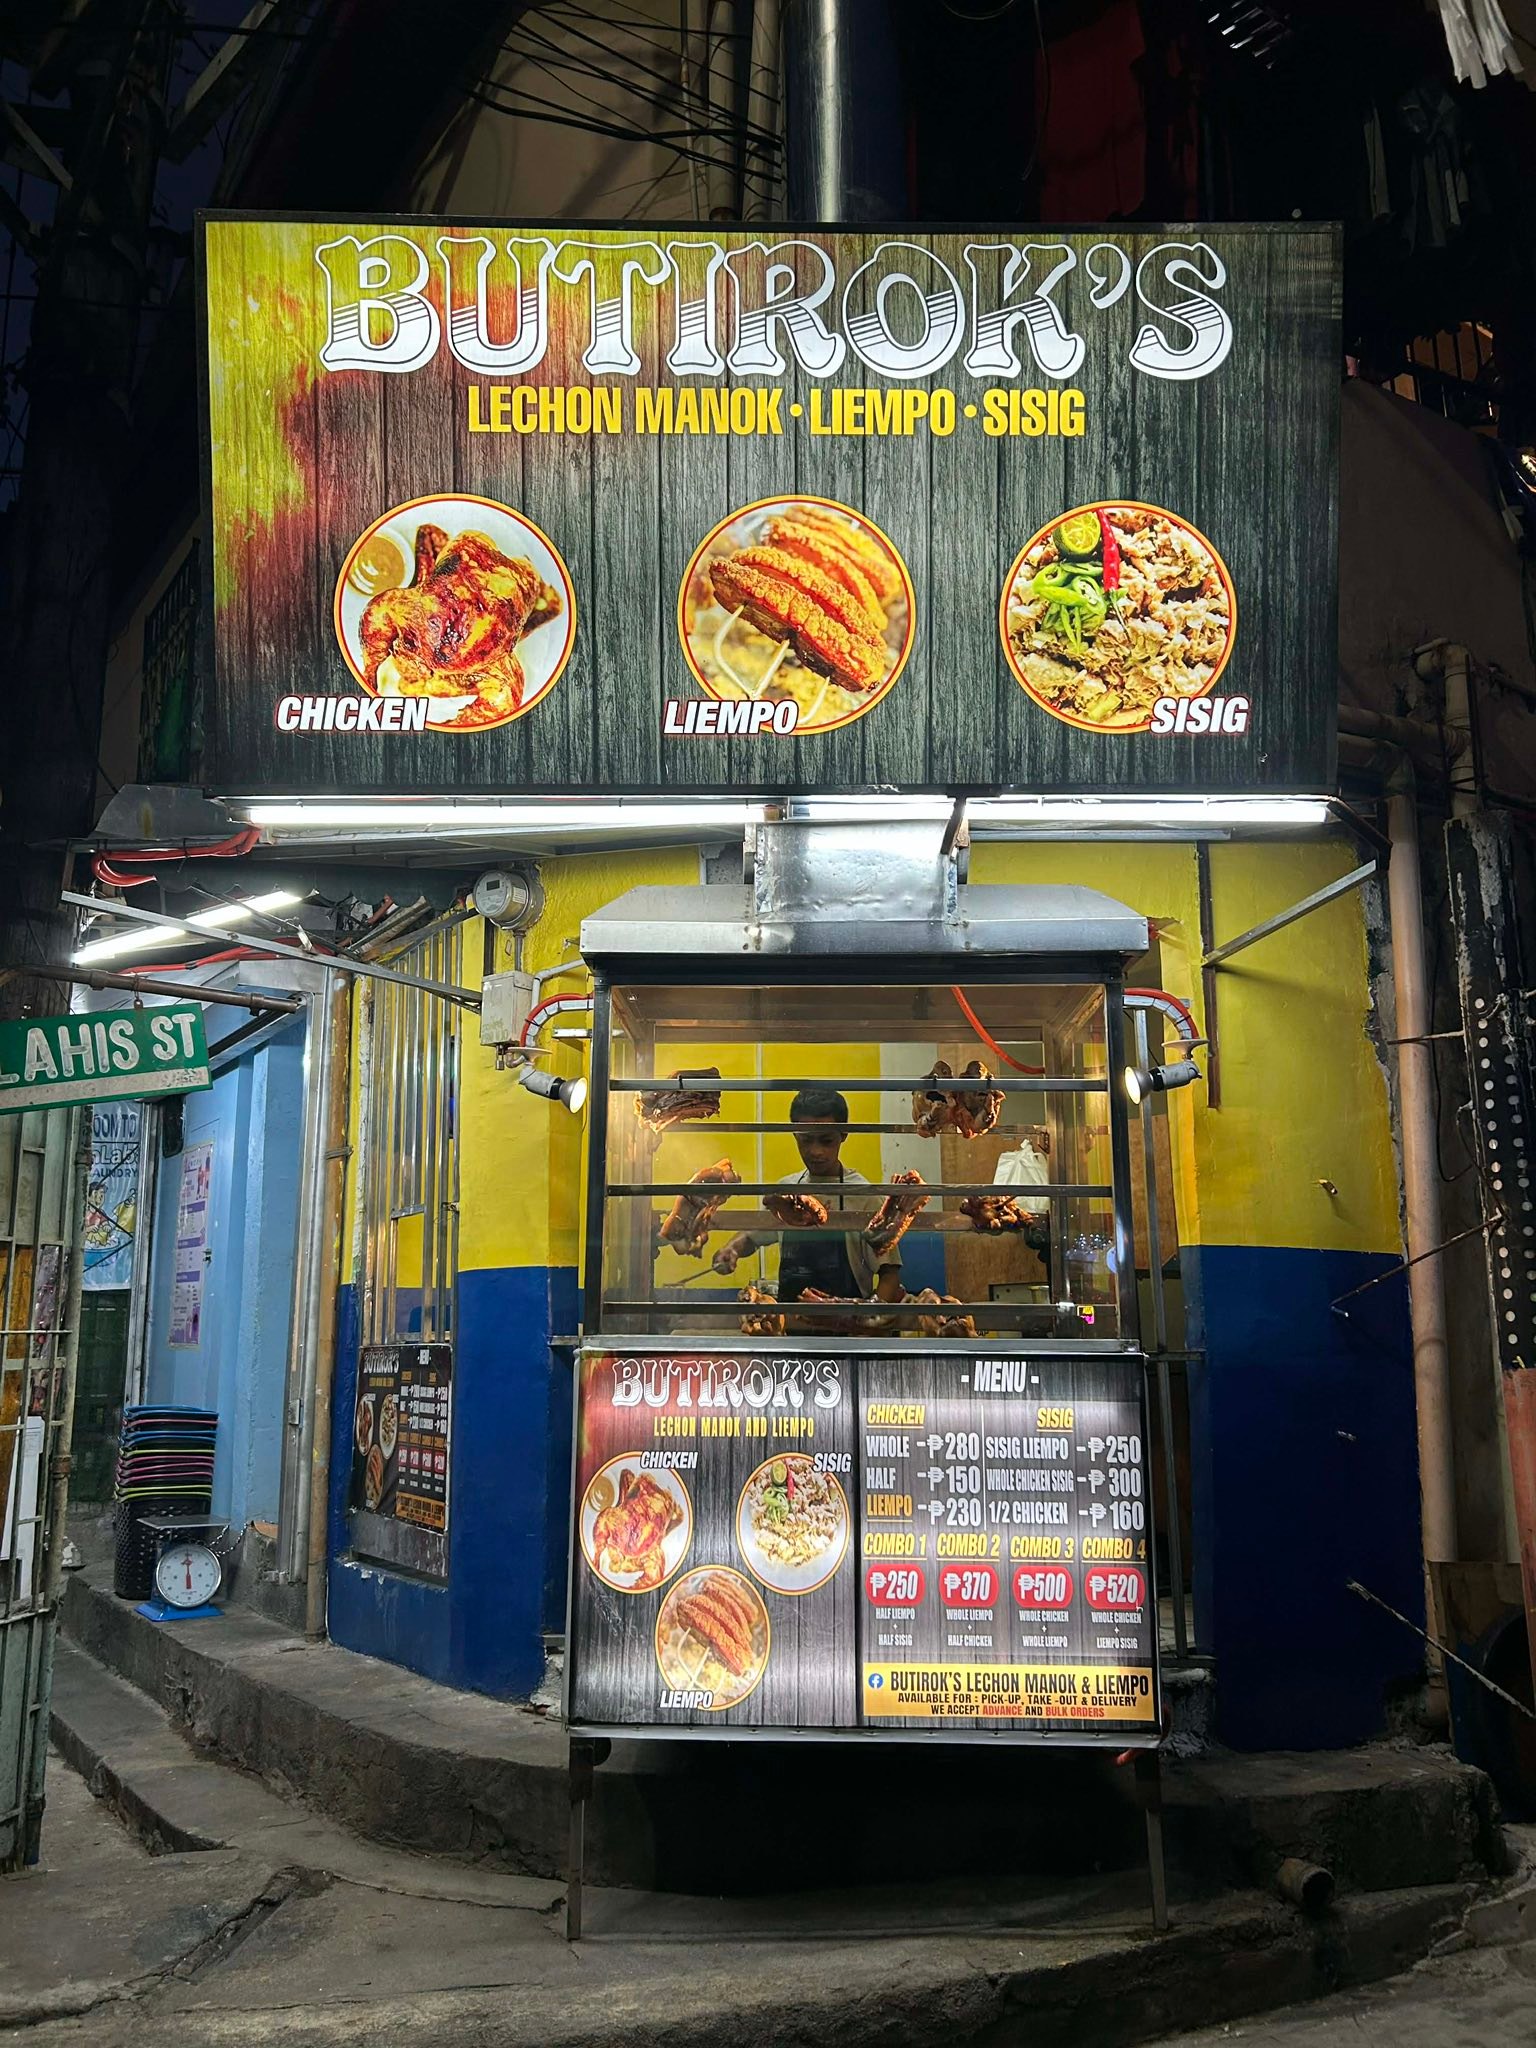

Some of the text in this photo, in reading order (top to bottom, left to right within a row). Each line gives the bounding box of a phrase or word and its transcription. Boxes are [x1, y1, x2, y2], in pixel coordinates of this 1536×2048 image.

[314, 235, 1233, 380] BUTIROK'S
[468, 385, 1085, 437] LECHON MANOK LIEMPO SISIG
[276, 695, 429, 734] CHICKEN
[663, 699, 800, 736] LIEMPO
[1149, 695, 1250, 735] SISIG
[151, 1013, 196, 1061] ST
[611, 1359, 842, 1408] BUTIROK'S
[867, 1404, 925, 1425] CHICKEN
[1037, 1407, 1074, 1429] SISIG
[654, 1416, 814, 1438] LECHON MANOK AND LIEMPO
[866, 1435, 910, 1458] WHOLE
[986, 1436, 1021, 1459] SISIG
[1023, 1437, 1068, 1460] LIEMPO
[640, 1452, 698, 1469] CHICKEN
[812, 1452, 851, 1473] SISIG
[866, 1467, 896, 1490] HALF
[987, 1468, 1014, 1491] WHOLE
[1015, 1468, 1051, 1492] CHICKEN
[1052, 1469, 1074, 1493] SISIG
[867, 1494, 912, 1516] LIEMPO
[989, 1501, 1010, 1524] 1/2
[1013, 1502, 1068, 1525] CHICKEN
[864, 1532, 926, 1557] COMBO 1
[937, 1533, 1000, 1557] COMBO 2
[1010, 1535, 1074, 1558] COMBO 3
[1082, 1537, 1146, 1560] COMBO 4
[876, 1608, 915, 1620] HALF LIEMPO
[947, 1609, 993, 1621] WHOLE LIEMPO
[1019, 1610, 1069, 1622] WHOLE CHICKEN
[1091, 1612, 1142, 1624] WHOLE CHICKEN
[879, 1634, 912, 1646] HALF SISIG
[948, 1635, 992, 1647] HALF CHICKEN
[1022, 1635, 1068, 1648] WHOLE LIEMPO
[1097, 1637, 1138, 1649] LIEMPO SISIG
[891, 1671, 1149, 1696] BUTIROK'S LECHON MANOK & LIEMPO
[659, 1690, 714, 1709] LIEMPO
[898, 1693, 950, 1703] AVAILABLE
[953, 1693, 972, 1704] FOR
[1027, 1695, 1052, 1705] TAKE
[1081, 1696, 1088, 1706] &
[1091, 1696, 1137, 1707] DELIVERY
[931, 1705, 1105, 1718] WE ACCEPT ADVANCE AND BULK ORDERS
